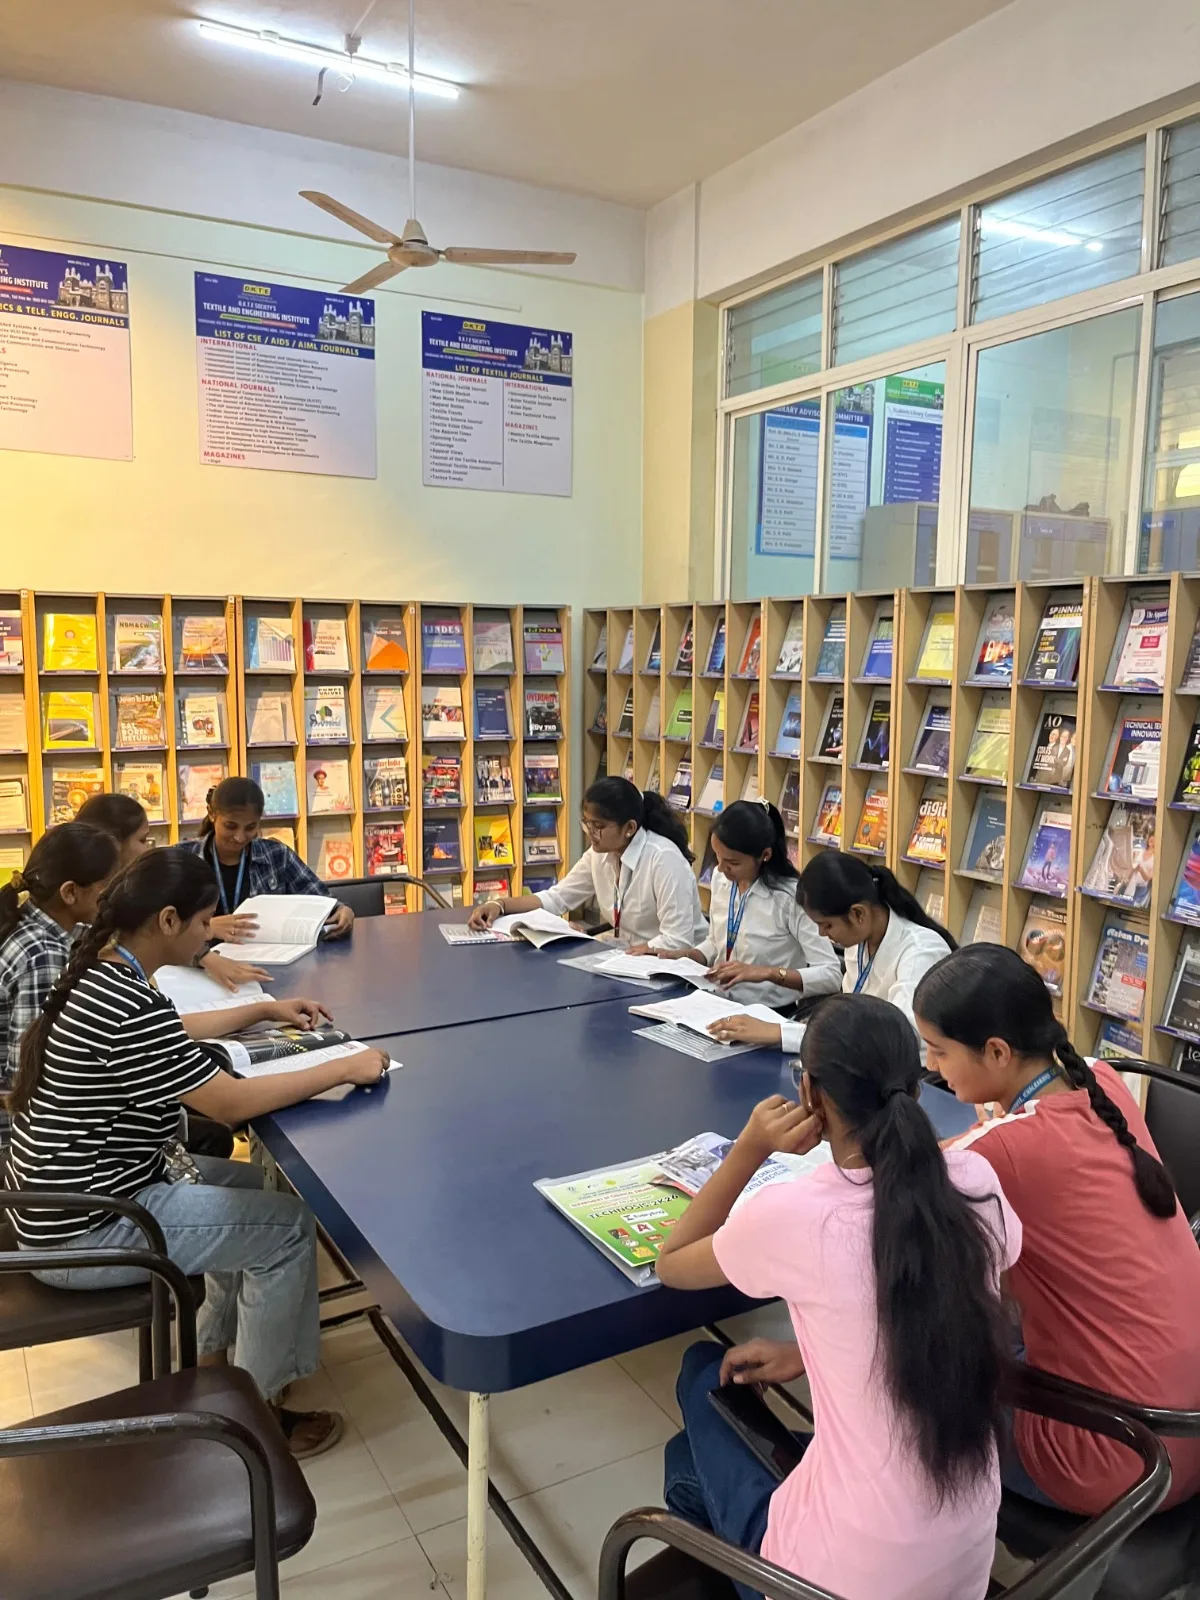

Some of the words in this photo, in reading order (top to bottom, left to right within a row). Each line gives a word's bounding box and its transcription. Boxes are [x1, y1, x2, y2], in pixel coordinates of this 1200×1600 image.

[14, 278, 48, 289] INSTITUTE
[26, 306, 48, 316] TELE.
[51, 311, 78, 320] ENGG.
[80, 314, 125, 326] JOURNALS
[203, 302, 226, 312] TEXTILE
[242, 308, 280, 320] ENGINEERING
[282, 314, 310, 325] INSTITUTE
[200, 338, 257, 350] INTERNATIONAL
[214, 329, 231, 338] LIST
[248, 334, 262, 342] CSE
[271, 337, 289, 346] AIDS
[298, 341, 318, 350] AIML
[320, 344, 359, 356] JOURNALS
[429, 338, 448, 347] TEXTILE
[461, 343, 493, 353] ENGINEERING
[494, 347, 518, 357] INSTITUTE
[426, 372, 456, 380] NATIONAL
[458, 376, 487, 384] JOURNALS
[482, 368, 507, 378] TEXTILE
[510, 372, 543, 382] JOURNALS
[202, 379, 238, 388] NATIONAL
[240, 384, 275, 392] JOURNALS
[504, 382, 549, 392] INTERNATIONAL
[505, 422, 538, 430] MAGAZINES
[204, 450, 246, 460] MAGAZINES
[1125, 721, 1154, 729] TECHNICAL
[478, 760, 500, 768] SME
[920, 801, 947, 816] digit
[1107, 928, 1132, 941] Asian
